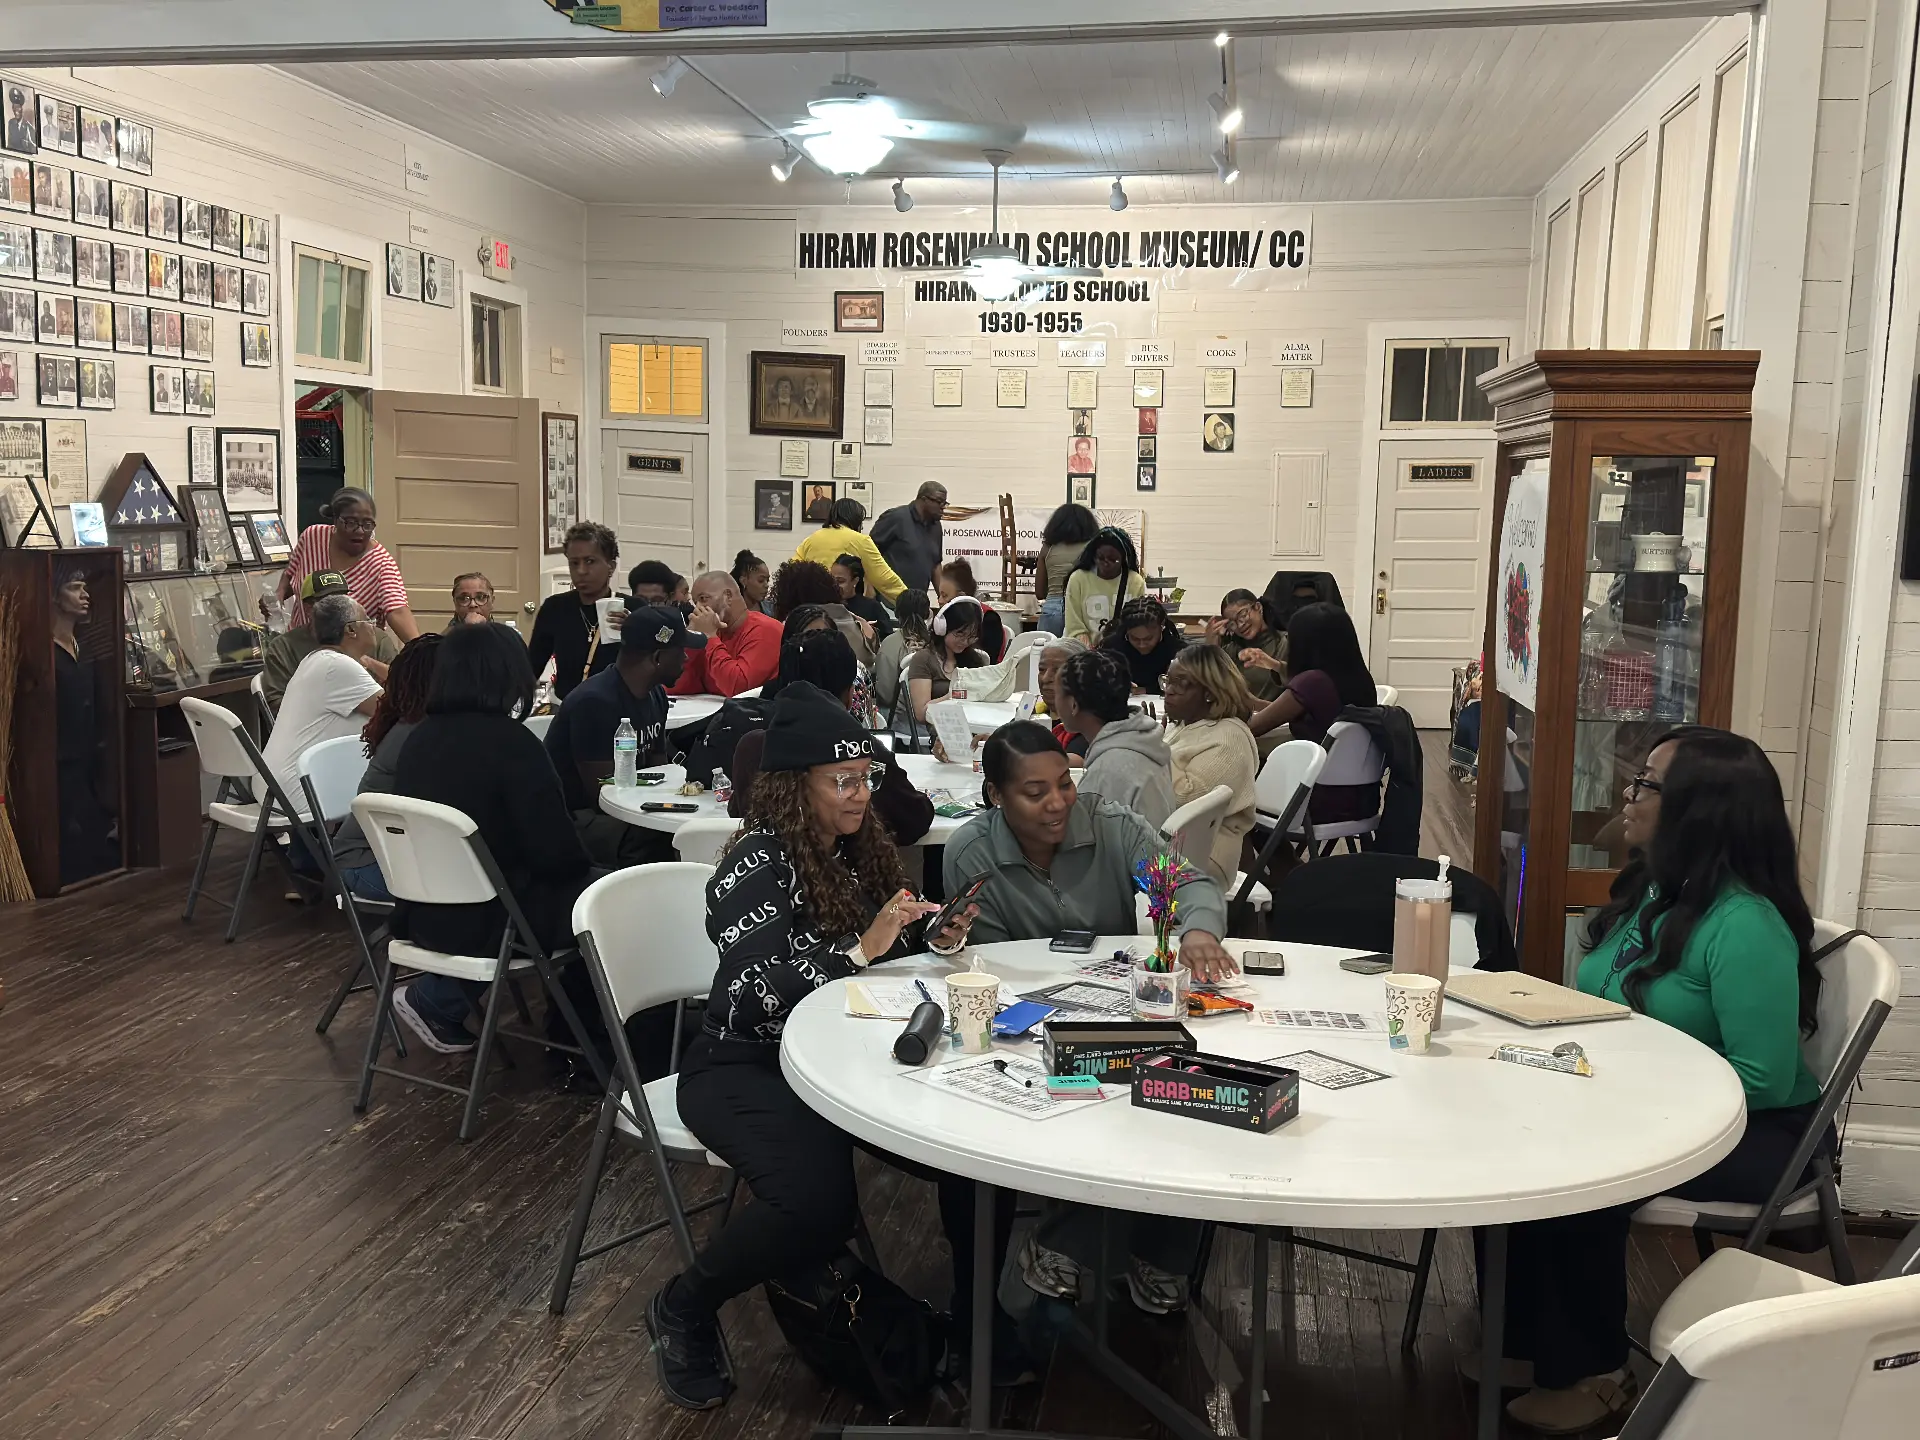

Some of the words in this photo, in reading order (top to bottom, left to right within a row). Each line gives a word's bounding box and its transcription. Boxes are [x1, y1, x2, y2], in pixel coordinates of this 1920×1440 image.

[799, 232, 877, 268] HIRAM
[1036, 231, 1133, 268] SCHOOL
[1268, 230, 1305, 268] CC
[495, 241, 509, 270] EXIT
[914, 280, 977, 302] HIRAM
[1073, 280, 1150, 302] SCHOOL
[978, 311, 1083, 333] 1930-1955
[783, 329, 828, 338] FOUNDERS
[1141, 344, 1159, 352] BUS
[1284, 343, 1310, 351] ALMA
[993, 349, 1036, 358] TRUSTEES
[1060, 350, 1105, 358] TEACHERS
[1131, 354, 1169, 362] DRIVERS
[1206, 349, 1237, 357] COOKS
[1281, 353, 1313, 361] MATER
[637, 458, 672, 469] GENTS
[1419, 468, 1464, 477] LADIES
[952, 529, 1002, 538] ROSENWALD
[1005, 530, 1039, 538] SHOOL
[714, 849, 770, 899] FOCUS
[717, 901, 778, 953] FOCUS
[1072, 1057, 1108, 1076] MIC
[1108, 1057, 1133, 1069] THE
[1142, 1078, 1191, 1100] GRAB
[1190, 1087, 1214, 1100] THE
[1215, 1085, 1249, 1107] MIC
